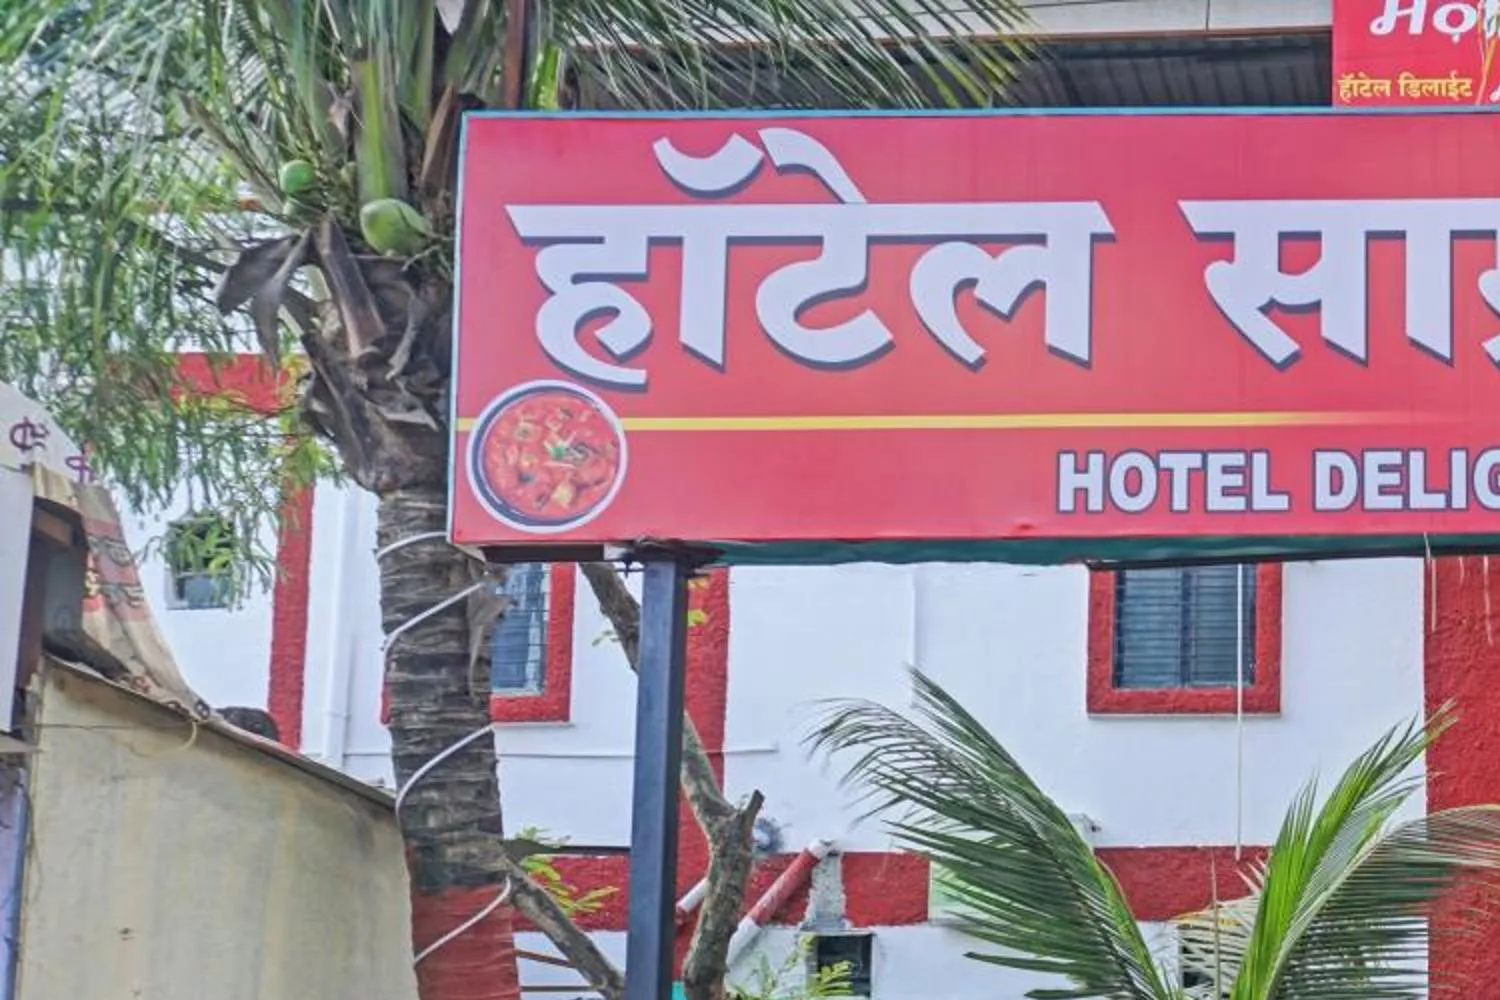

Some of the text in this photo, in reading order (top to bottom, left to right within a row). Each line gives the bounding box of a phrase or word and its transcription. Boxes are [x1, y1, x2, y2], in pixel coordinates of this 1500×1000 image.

[1399, 71, 1473, 101] डिलाईट
[505, 127, 1116, 388] हॉटेल
[1056, 449, 1290, 513] HOTEL
